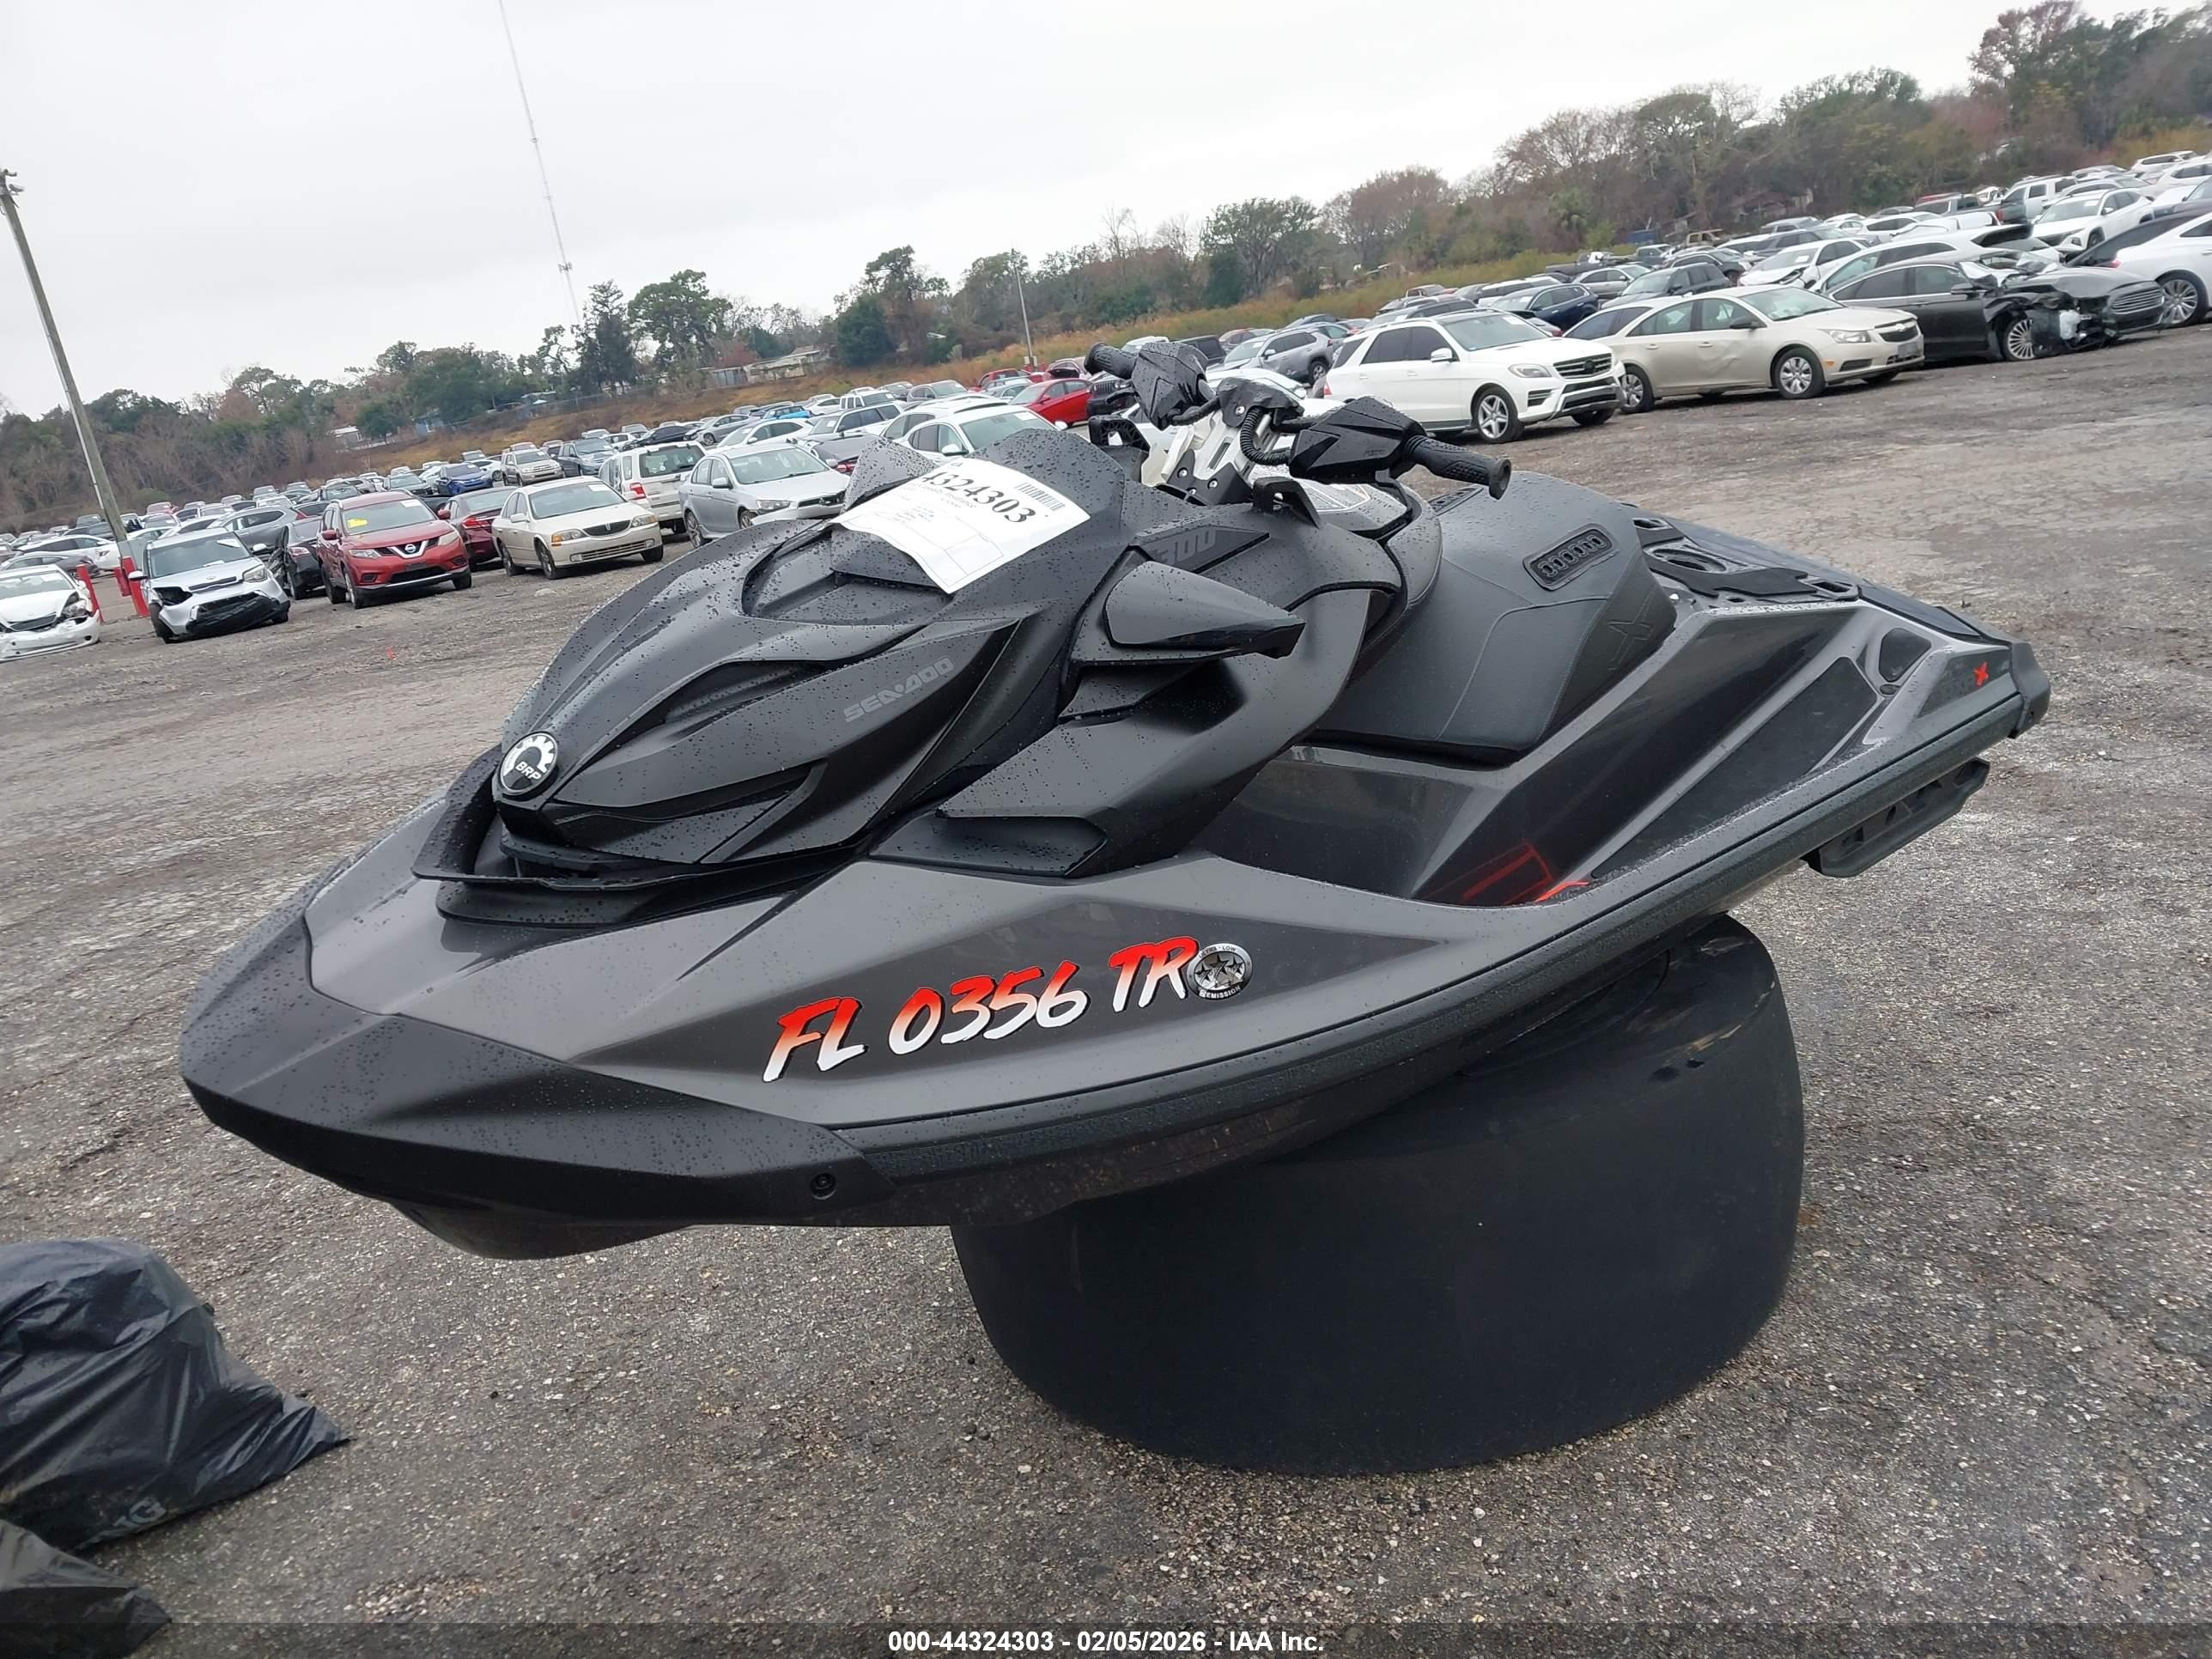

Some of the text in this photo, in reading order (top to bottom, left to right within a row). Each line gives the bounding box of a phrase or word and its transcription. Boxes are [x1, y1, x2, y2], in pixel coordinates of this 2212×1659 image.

[515, 761, 542, 780] BRP
[763, 936, 1200, 1082] FL 0356 TR
